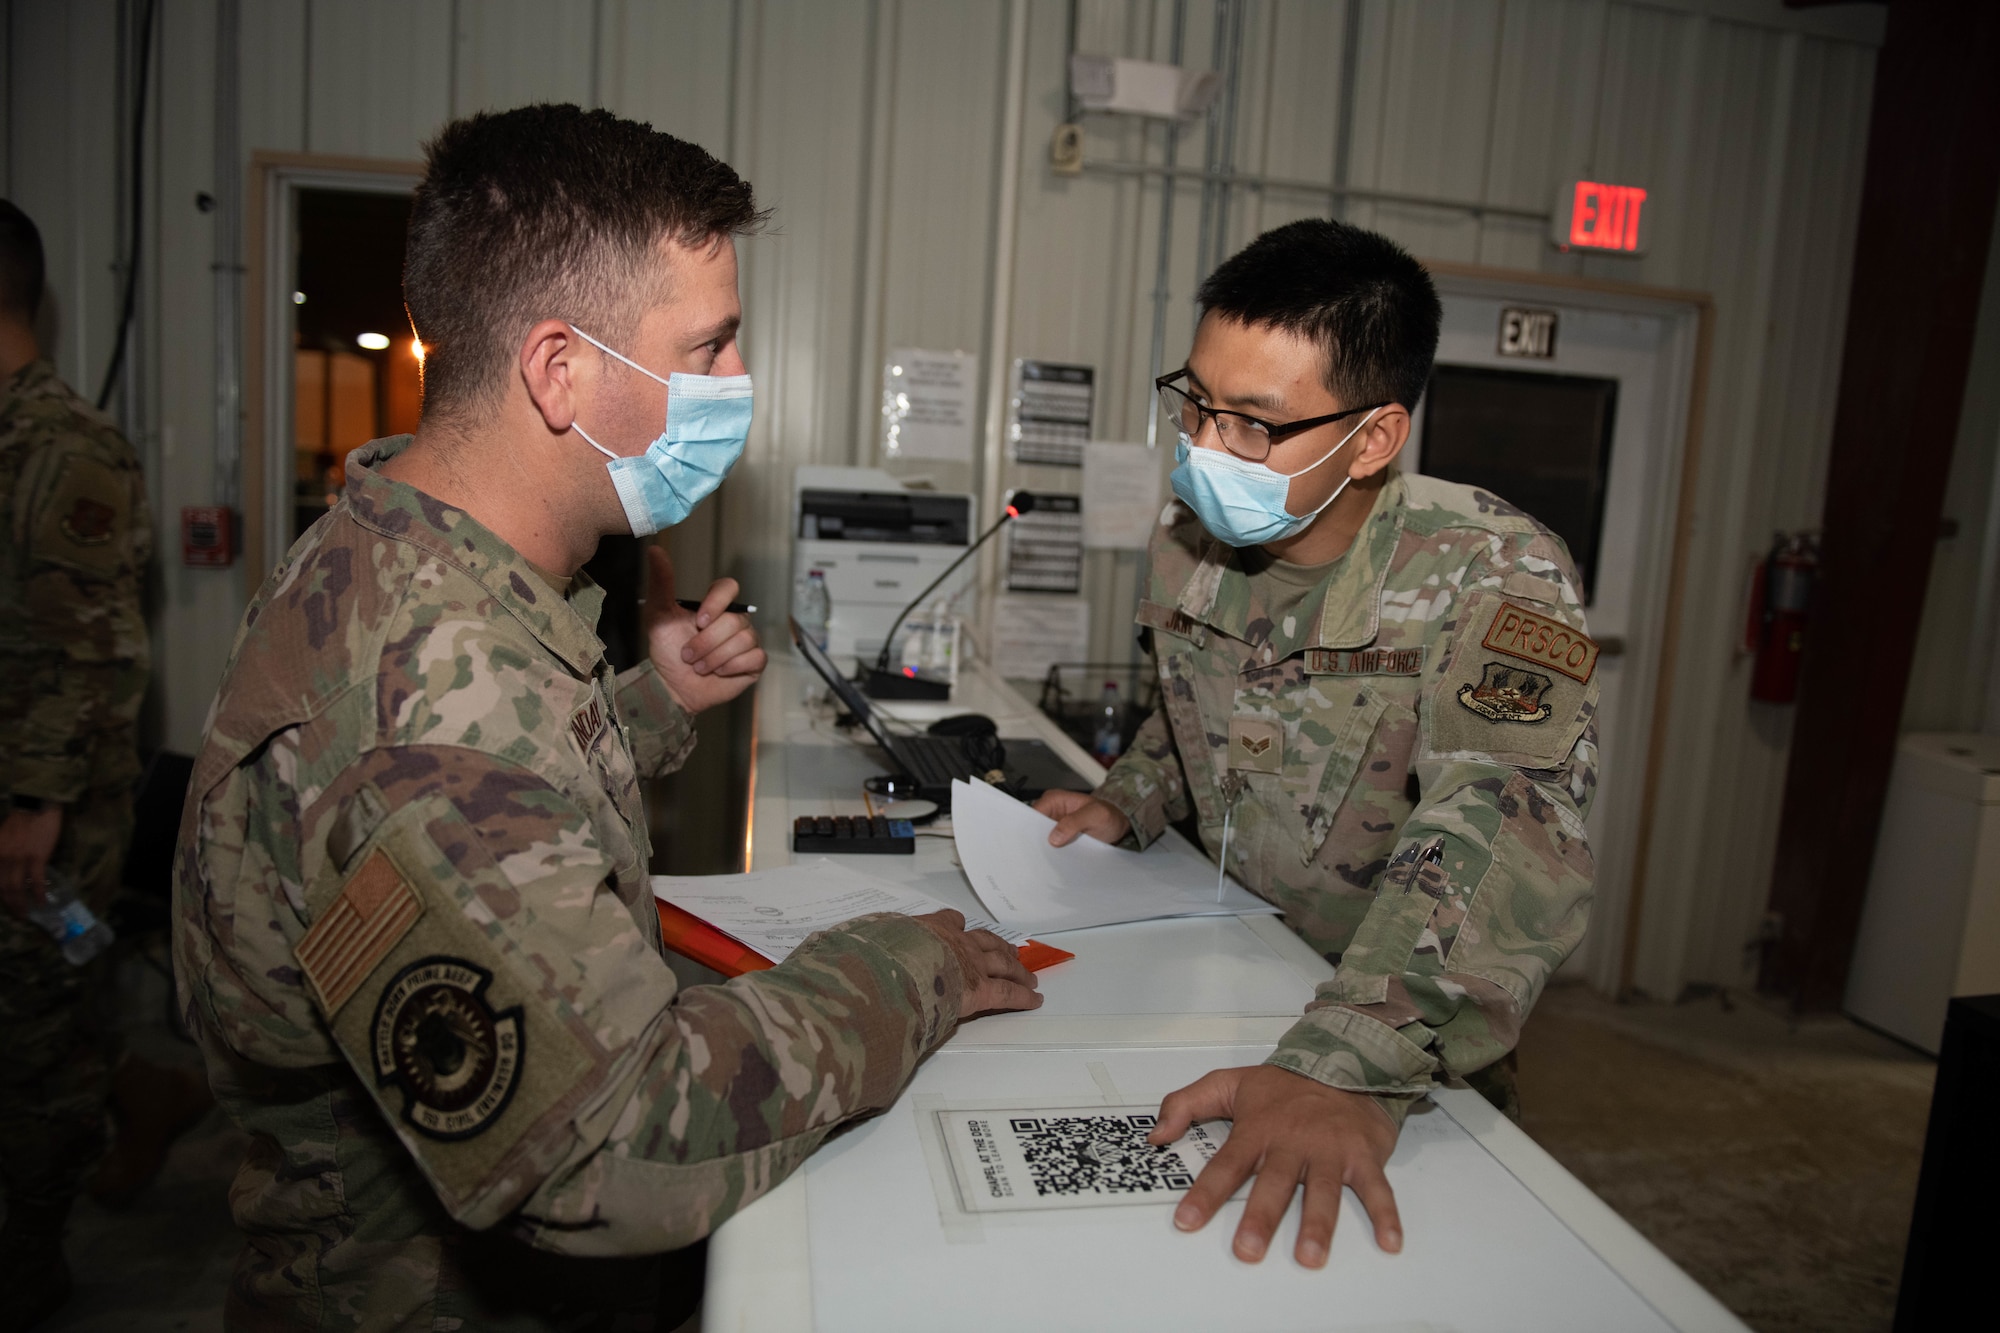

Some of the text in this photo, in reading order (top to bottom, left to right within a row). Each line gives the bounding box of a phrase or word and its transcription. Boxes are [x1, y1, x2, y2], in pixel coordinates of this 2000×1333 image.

[1570, 181, 1647, 251] EXIT
[1502, 311, 1552, 354] EXIT
[1312, 648, 1422, 673] U.S. AIR FORCE
[1494, 612, 1588, 668] PRSCO
[967, 1119, 1004, 1198] CHAPEL AT THE DEID
